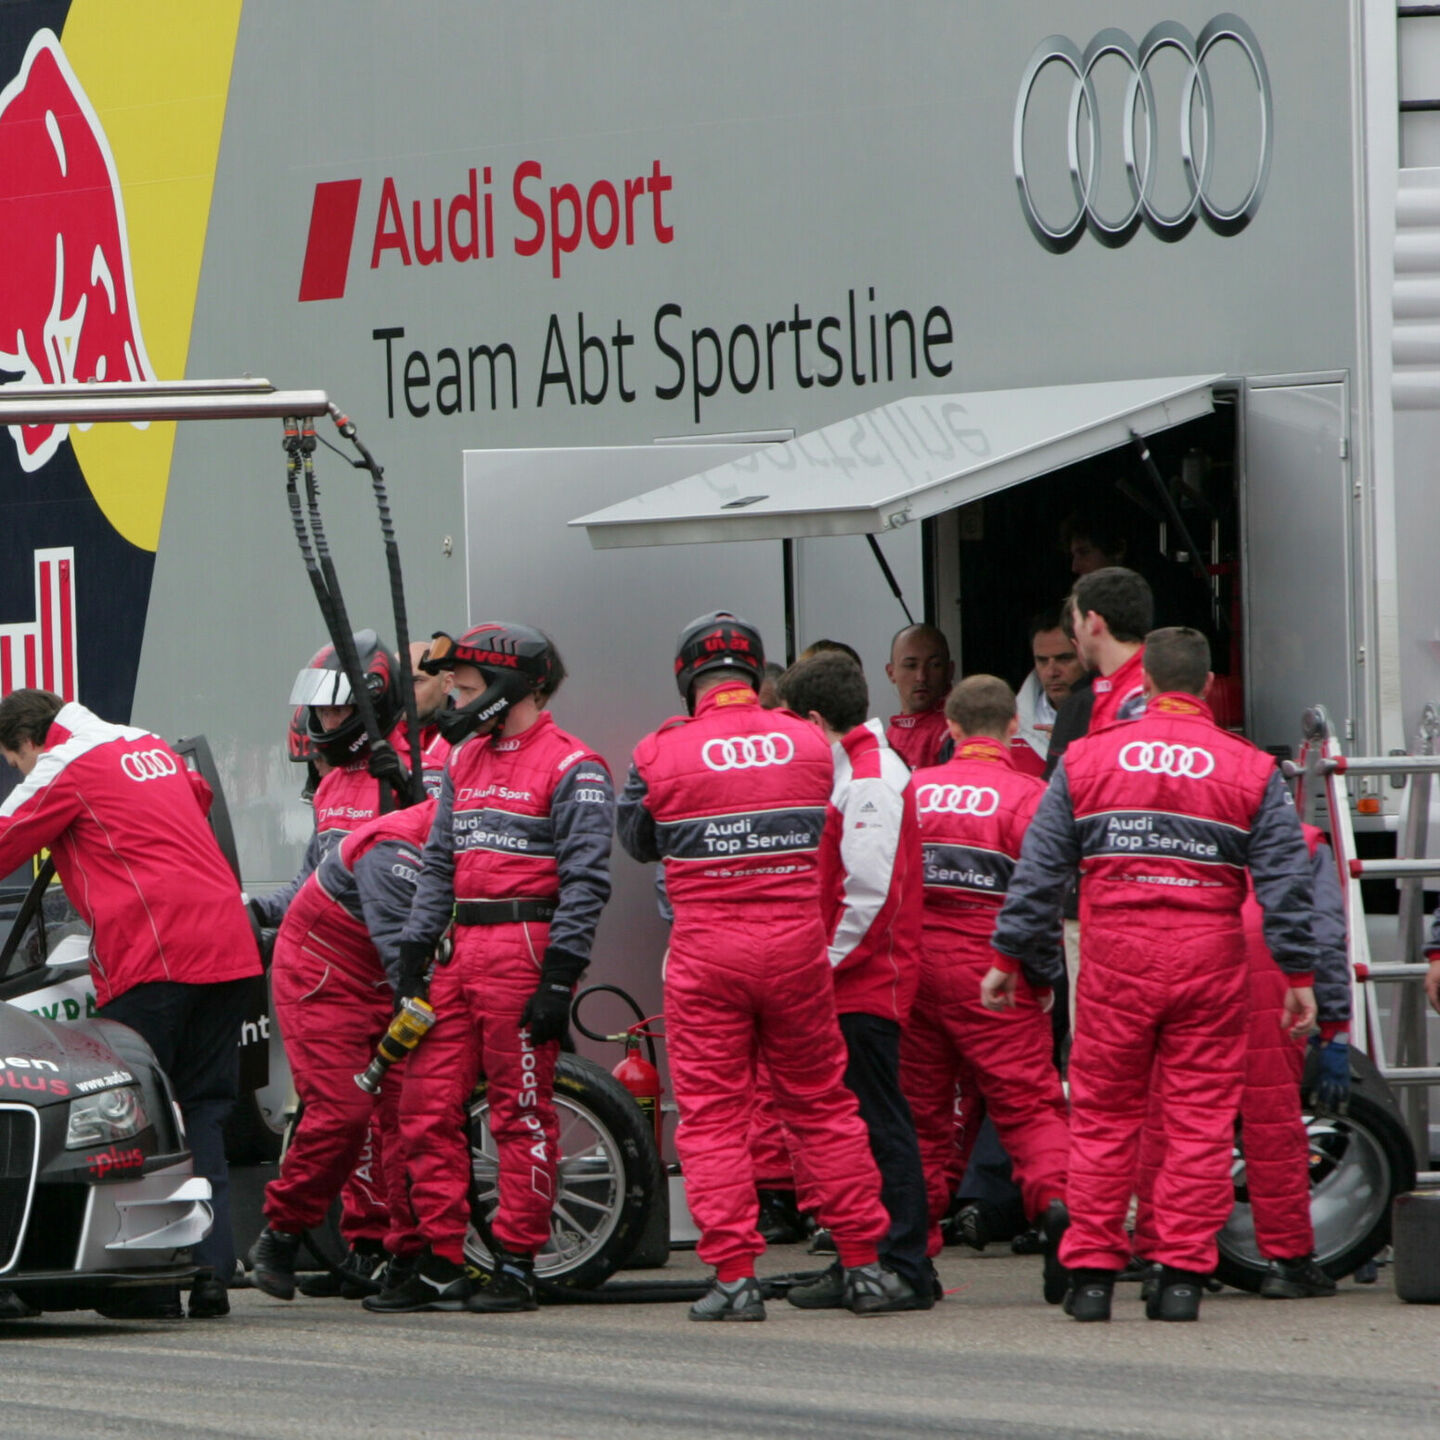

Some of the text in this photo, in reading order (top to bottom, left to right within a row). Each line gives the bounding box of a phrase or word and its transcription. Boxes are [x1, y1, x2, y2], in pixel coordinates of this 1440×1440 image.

[369, 160, 675, 279] Audi Sport
[372, 286, 953, 424] Team Abt Sportsline
[454, 646, 518, 668] uvex
[478, 697, 509, 720] uvex
[348, 731, 369, 752] uve
[473, 785, 531, 801] Audi Sport
[327, 807, 374, 818] Audi Sport
[1108, 816, 1152, 831] Audi
[704, 819, 751, 836] Audi
[703, 830, 811, 854] Top Service
[1107, 833, 1218, 855] Top Service
[733, 865, 796, 876] DUNLOP
[927, 865, 995, 886] Service
[1136, 876, 1200, 887] DUNLOP
[518, 1028, 538, 1108] Sport
[76, 1070, 133, 1093] www.audi.tv
[86, 1145, 145, 1179] :plus
